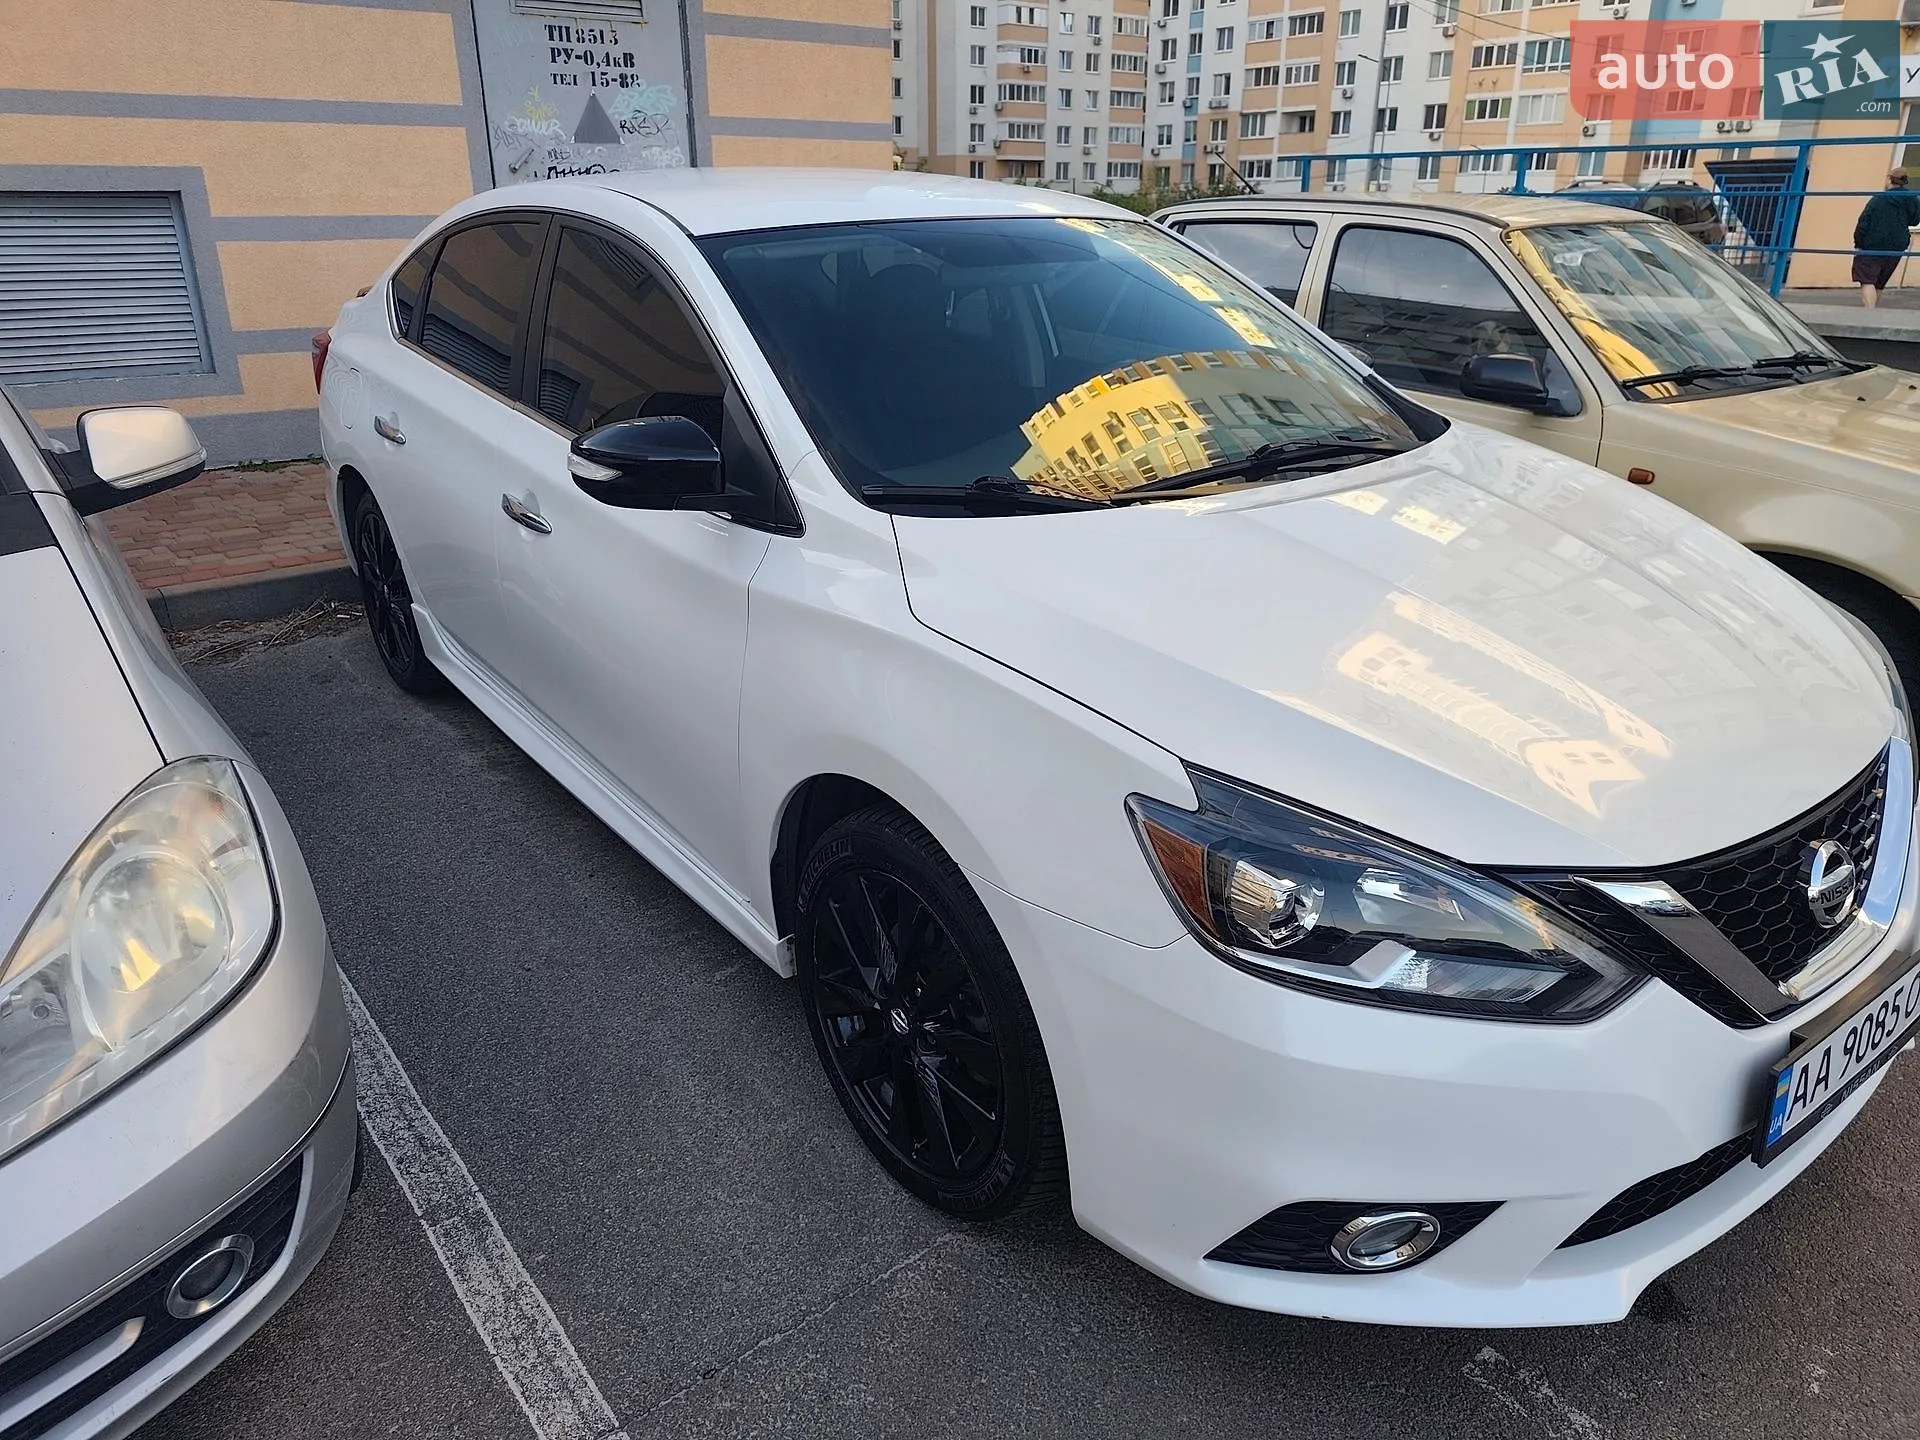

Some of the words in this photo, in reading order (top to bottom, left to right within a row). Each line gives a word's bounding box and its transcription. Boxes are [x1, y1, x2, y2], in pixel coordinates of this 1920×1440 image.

[1820, 879, 1852, 905] NISS
[1786, 1044, 1832, 1122] AA
[1839, 985, 1904, 1080] 9085
[1769, 1113, 1783, 1134] UA
